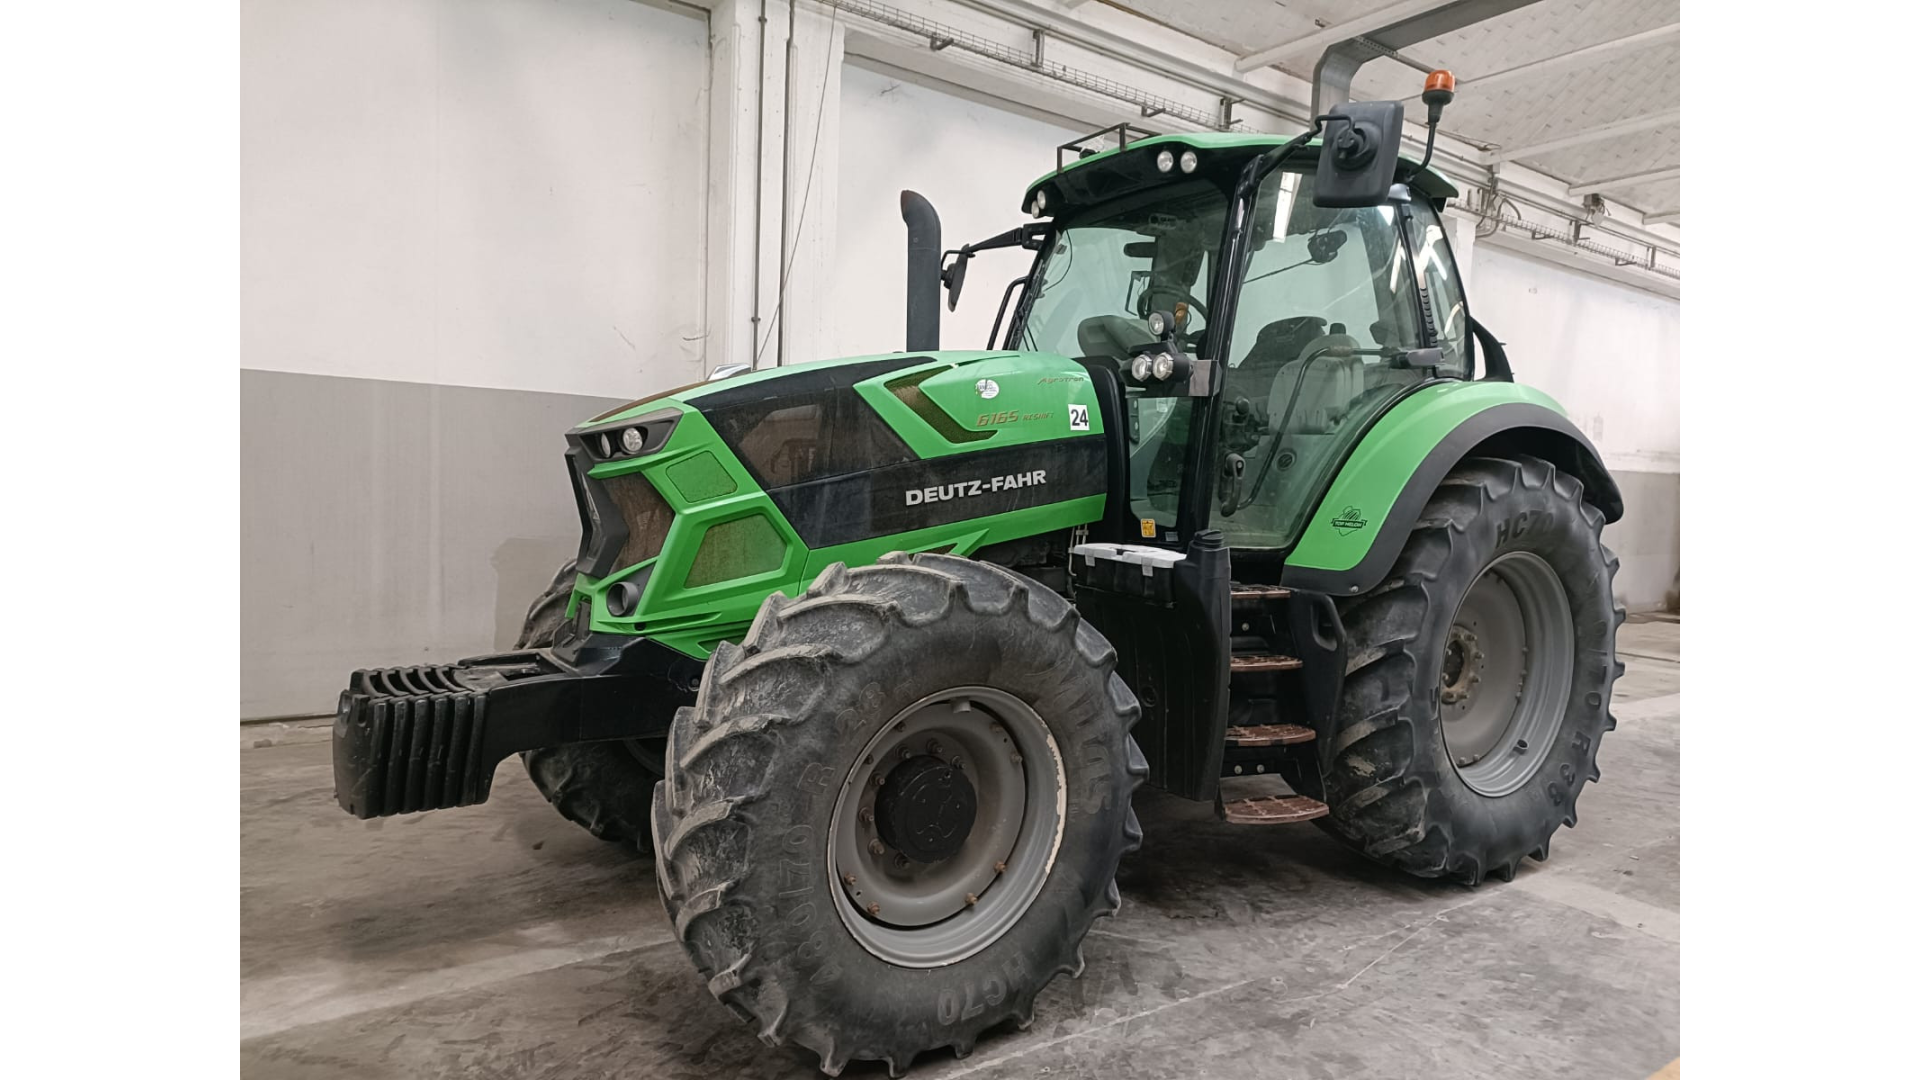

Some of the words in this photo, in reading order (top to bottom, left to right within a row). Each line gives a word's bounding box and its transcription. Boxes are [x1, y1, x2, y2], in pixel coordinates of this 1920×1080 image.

[1070, 408, 1089, 427] 24
[905, 469, 1047, 507] DEUTZ-FAHR
[1495, 510, 1555, 549] HC70
